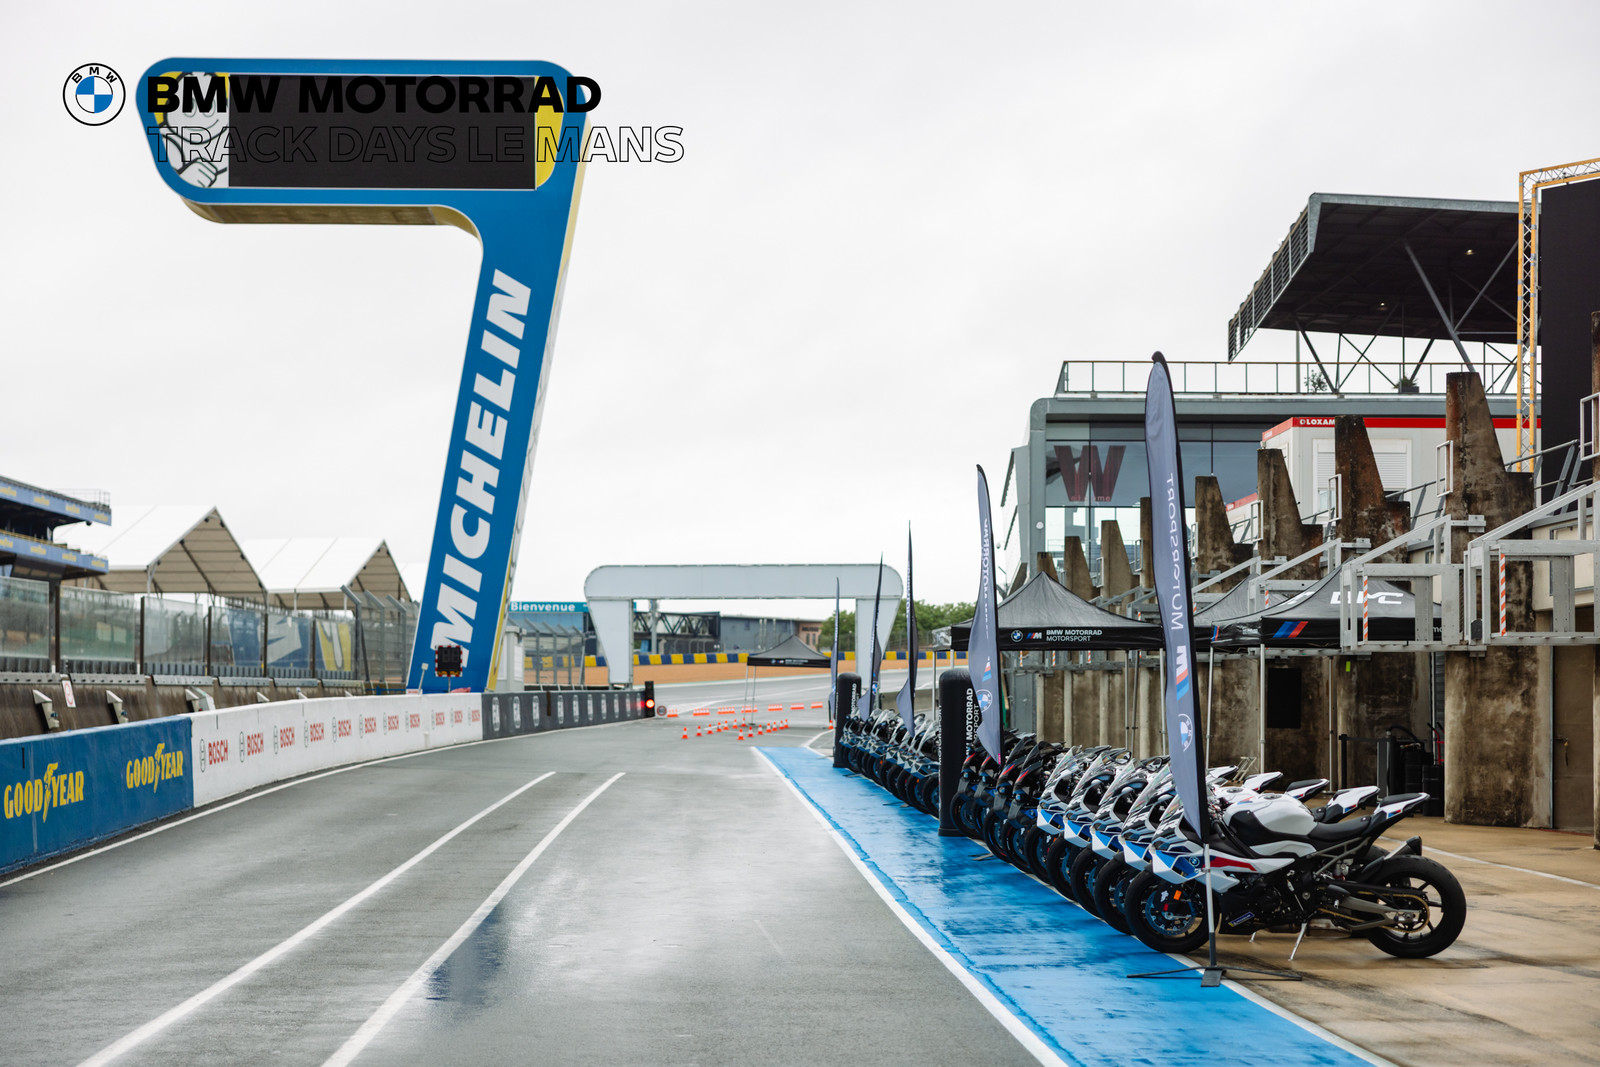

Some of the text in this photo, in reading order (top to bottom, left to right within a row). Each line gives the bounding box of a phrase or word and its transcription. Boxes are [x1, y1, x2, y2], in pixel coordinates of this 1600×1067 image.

[430, 269, 532, 667] MICHELIN
[510, 602, 576, 612] Bienvenue
[966, 688, 974, 740] MOTORRAD
[280, 727, 295, 748] BOSCH
[310, 723, 324, 742] BOSCH
[338, 720, 352, 737] BOSCH
[208, 740, 228, 765] BOSCH
[247, 733, 264, 756] BOSCH
[126, 750, 184, 789] GOODYEAR
[4, 770, 84, 820] GOODYEAR
